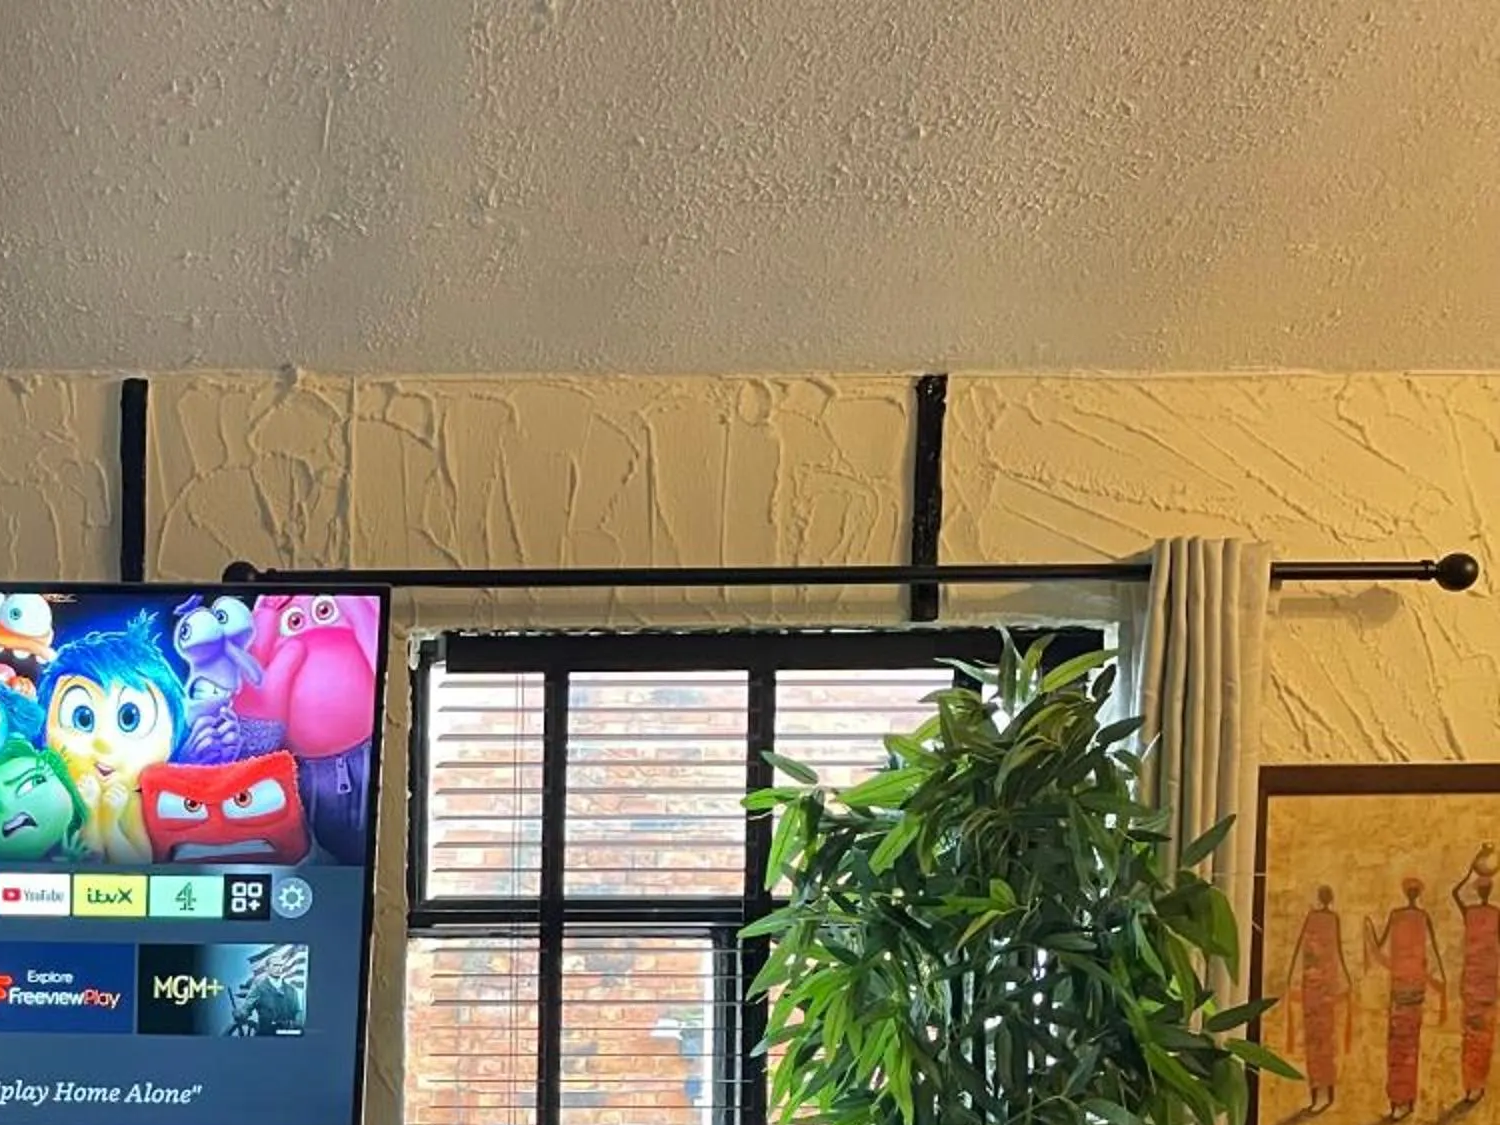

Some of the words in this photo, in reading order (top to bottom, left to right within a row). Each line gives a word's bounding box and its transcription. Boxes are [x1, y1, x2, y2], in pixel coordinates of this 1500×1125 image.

[23, 888, 64, 902] YouTube
[174, 881, 197, 911] 4
[27, 969, 74, 985] Explore
[153, 975, 225, 1005] MGM+
[53, 1081, 120, 1103] Home
